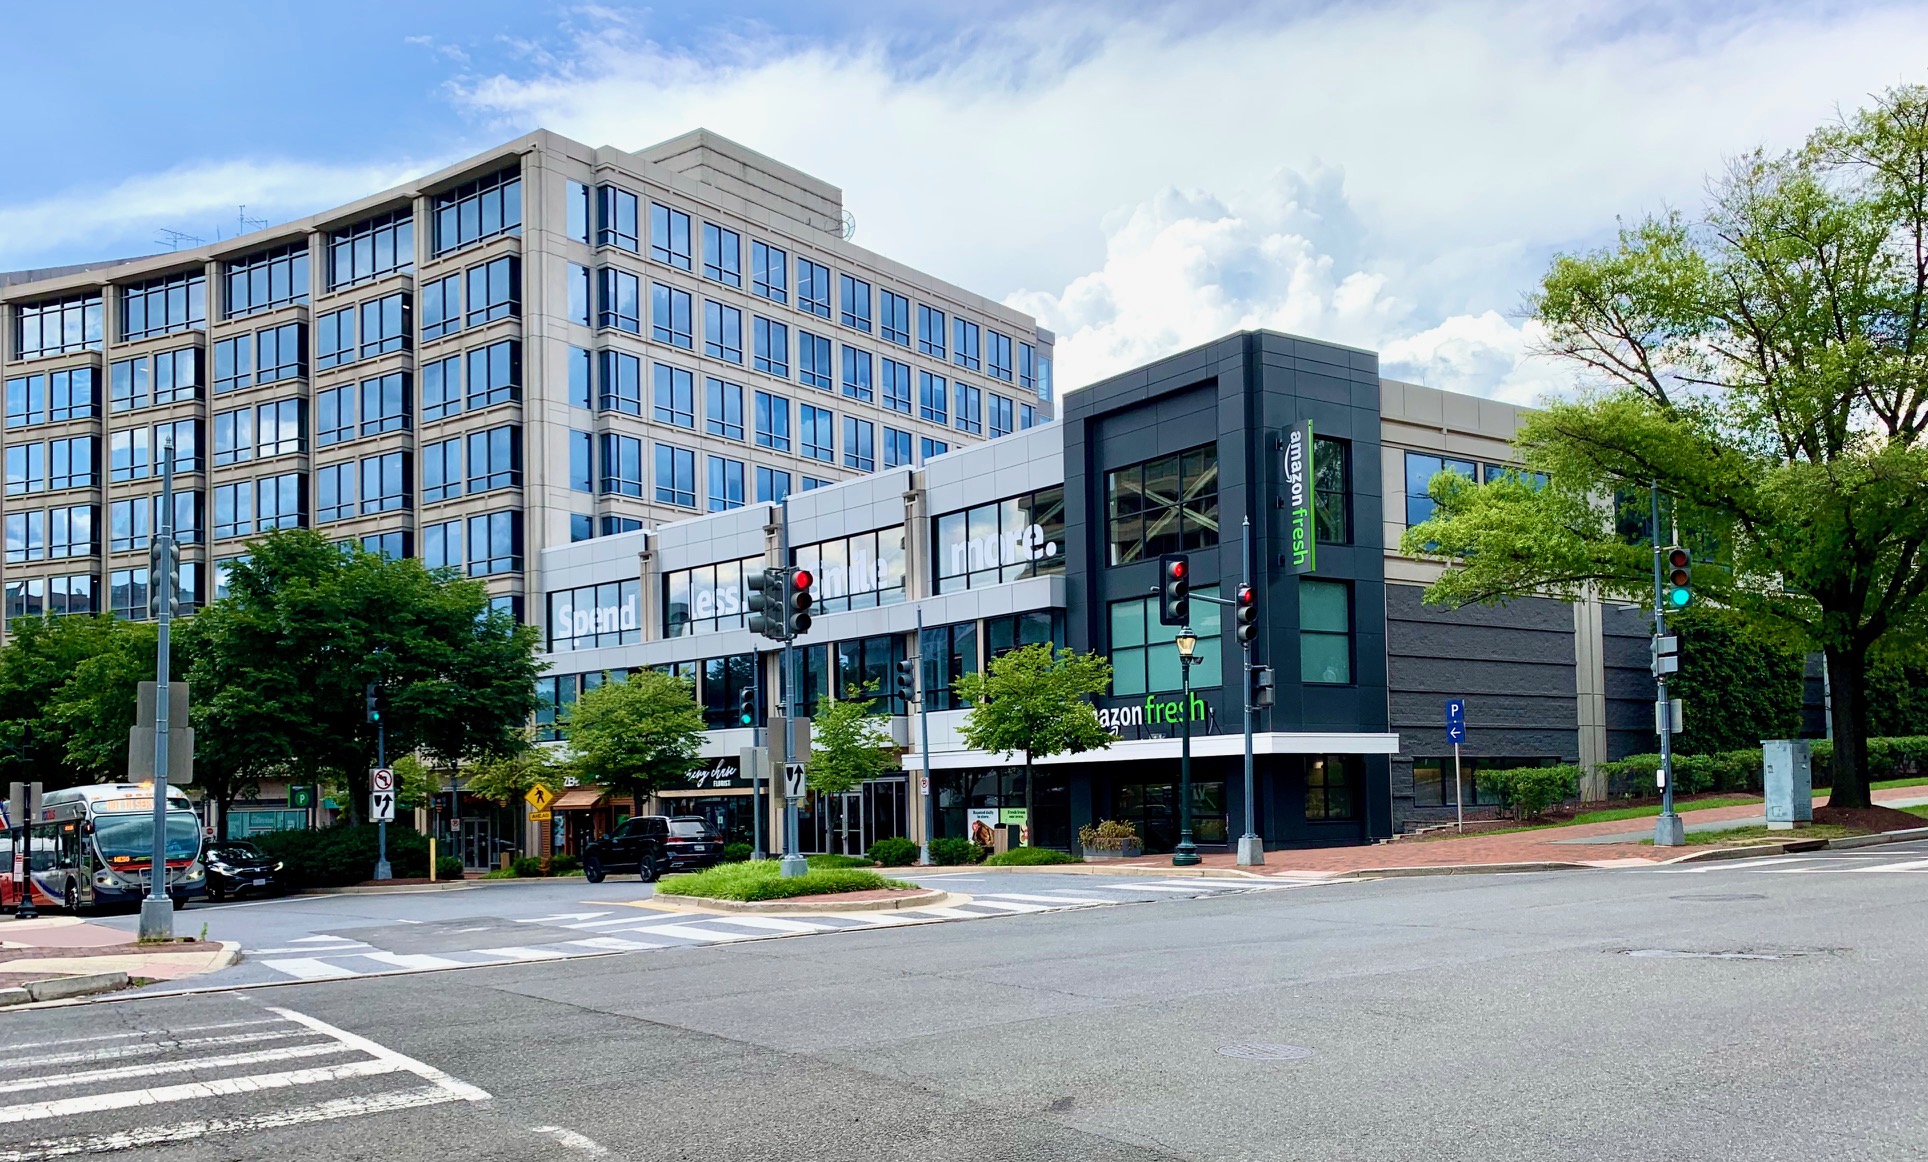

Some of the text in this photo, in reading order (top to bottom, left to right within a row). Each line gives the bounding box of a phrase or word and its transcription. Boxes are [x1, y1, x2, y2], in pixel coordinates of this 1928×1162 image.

[1290, 430, 1309, 566] amazon fresh
[558, 594, 637, 647] Spend
[951, 523, 1057, 576] more.
[1091, 704, 1143, 729] azon
[1451, 704, 1459, 717] P
[299, 794, 305, 804] P
